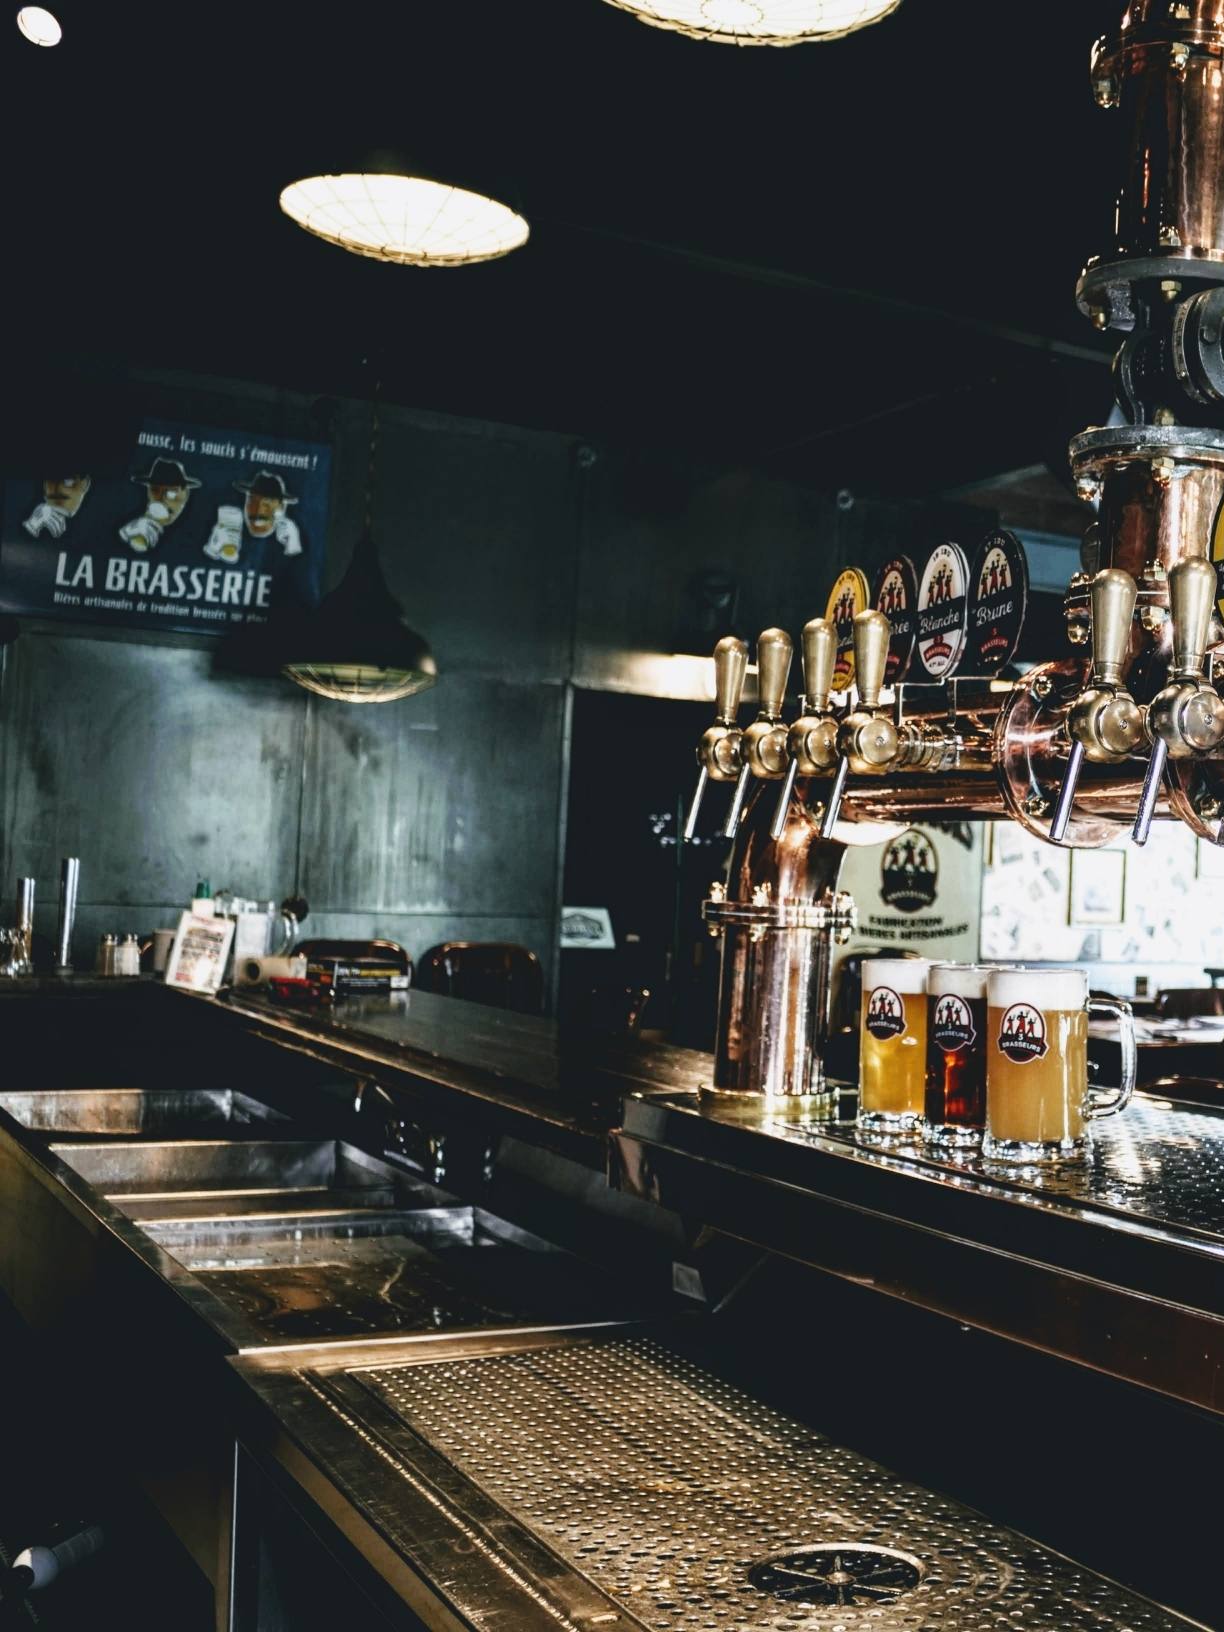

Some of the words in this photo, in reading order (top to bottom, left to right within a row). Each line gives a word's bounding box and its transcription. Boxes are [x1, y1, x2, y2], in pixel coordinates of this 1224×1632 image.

[138, 431, 174, 451] ousse,
[180, 435, 196, 453] les
[201, 441, 235, 460] soucis
[55, 552, 94, 590] LA
[84, 596, 133, 611] artisanales
[137, 600, 148, 613] de
[151, 601, 190, 617] tradition
[976, 599, 1014, 627] Brune
[919, 609, 959, 636] Blanche
[1002, 1041, 1041, 1053] BRASSEURS
[1018, 1033, 1024, 1041] 3
